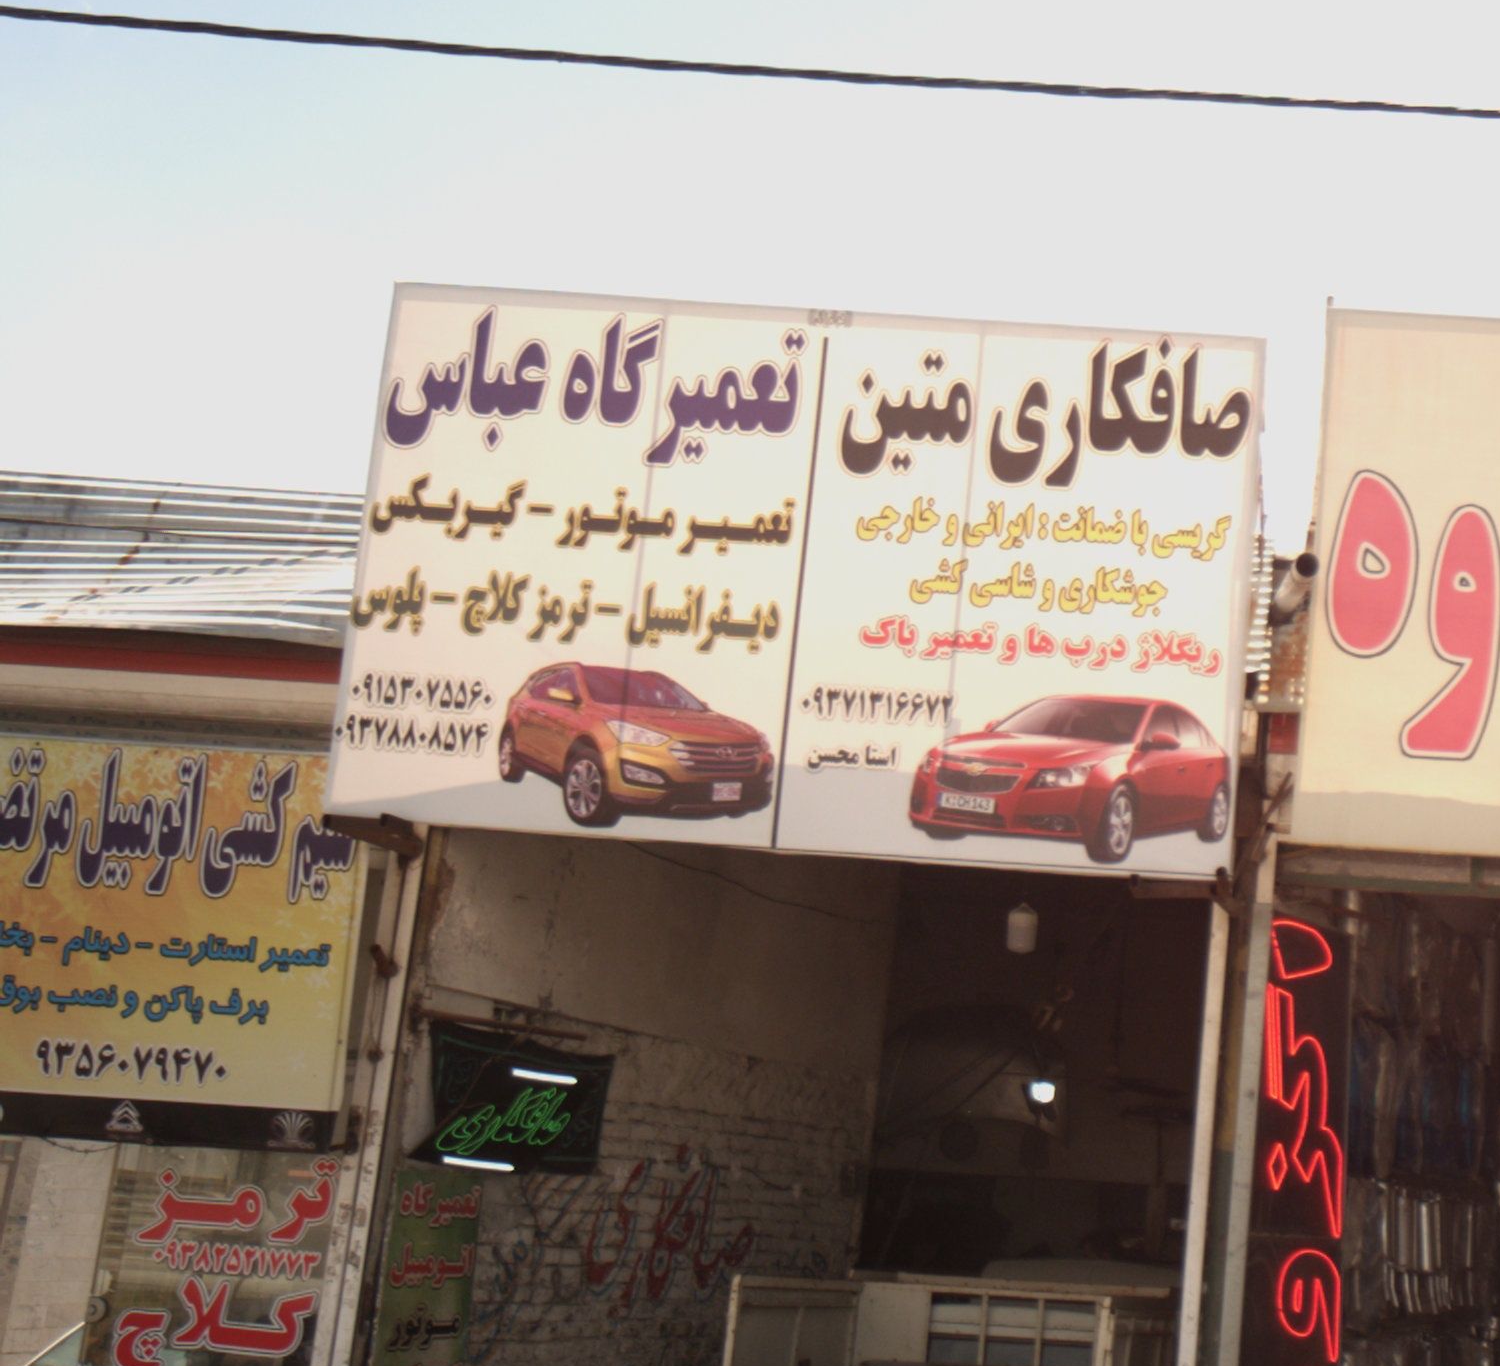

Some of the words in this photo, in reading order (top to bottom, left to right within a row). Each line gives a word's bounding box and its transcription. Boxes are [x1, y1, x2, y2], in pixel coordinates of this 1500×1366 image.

[385, 307, 549, 449] عباس
[839, 350, 975, 476] متین
[988, 337, 1252, 487] صافکاری
[370, 474, 526, 538] گیربکس
[557, 487, 674, 550] موتور
[677, 498, 796, 553] تعمیر
[857, 496, 939, 544] خارجی
[943, 510, 959, 546] و
[964, 501, 1034, 550] ایرانی
[1052, 505, 1126, 544] ضمانت
[1130, 509, 1149, 555] با
[351, 565, 426, 634] پلوس
[462, 571, 530, 633] کلاچ
[910, 559, 967, 603] کشی
[970, 562, 1036, 607] شاسی
[1039, 578, 1054, 611] و
[1059, 566, 1168, 617] جوشکاری
[527, 579, 593, 642] ترمز
[626, 583, 780, 651] دیفرانسیل
[859, 616, 918, 656] باک
[924, 624, 997, 659] تعمیر
[999, 632, 1018, 662] و
[1026, 625, 1055, 656] ها
[1061, 635, 1126, 669] درب
[1132, 632, 1221, 675] ریگلاژ
[808, 749, 859, 769] محسن
[0, 747, 75, 887] مرتض
[76, 748, 207, 895] اتومبیل
[200, 761, 297, 898] کشی
[62, 927, 130, 965] دینام
[160, 934, 257, 965] استارت
[259, 943, 331, 971] تعمیر
[48, 985, 118, 1012] نصب
[121, 989, 139, 1019] و
[144, 986, 203, 1024] پاکن
[210, 988, 269, 1024] برف
[36, 1038, 227, 1085] ۹۳۵۶۰۷۹۴۷۰
[135, 1156, 339, 1244] ترمز
